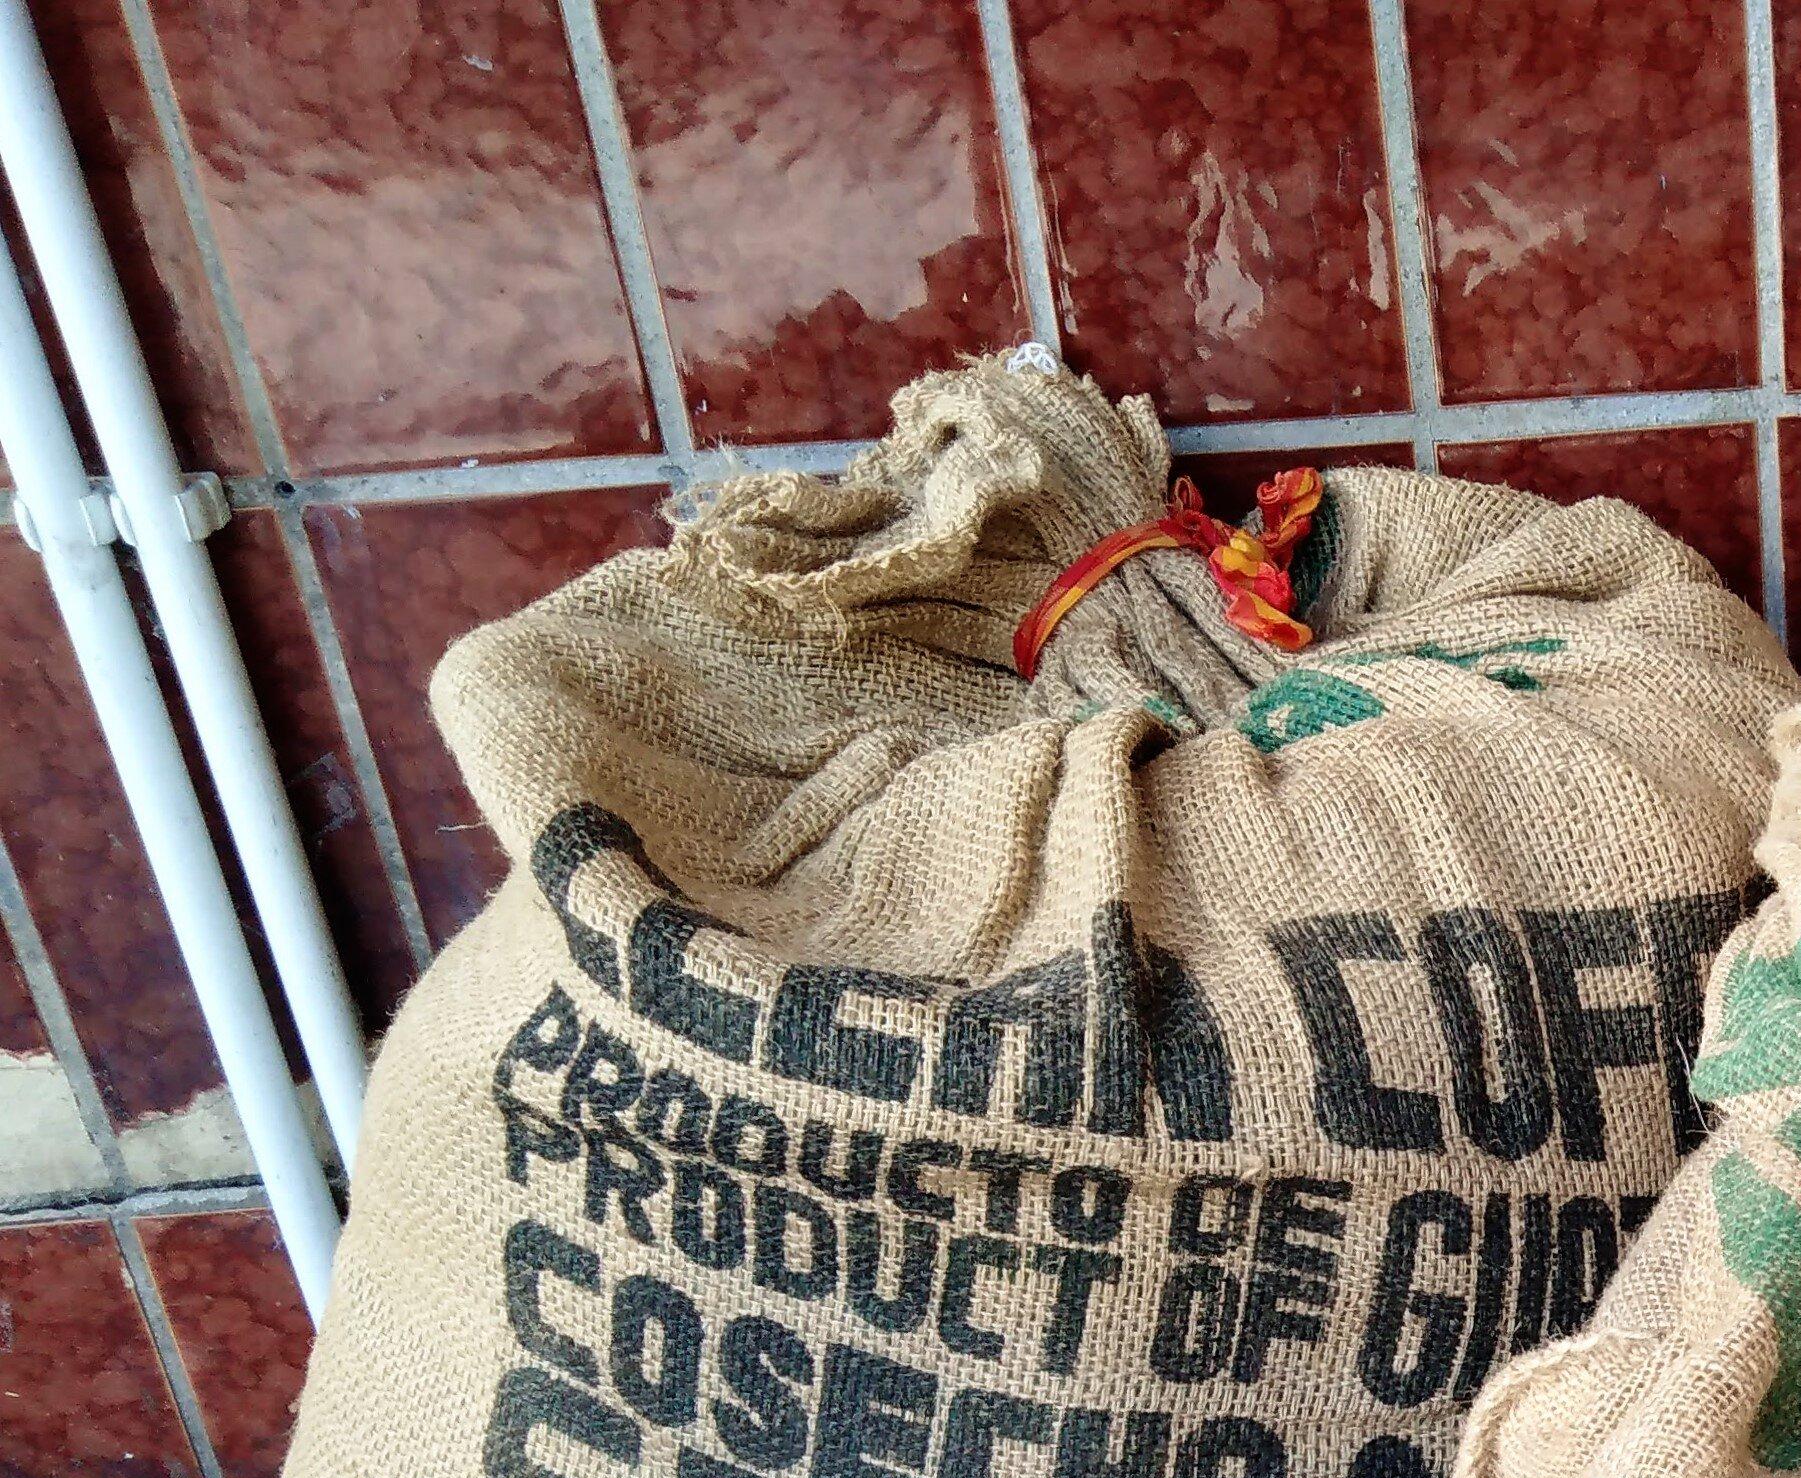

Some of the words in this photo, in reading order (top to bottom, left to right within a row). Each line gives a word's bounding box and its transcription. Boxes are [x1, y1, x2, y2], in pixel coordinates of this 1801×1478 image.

[492, 976, 1134, 1248] PRODUCTO
[1170, 1173, 1354, 1277] DE
[498, 1096, 1124, 1378] PRODUCT
[1146, 1262, 1338, 1387] OF
[1356, 1188, 1665, 1410] GUA
